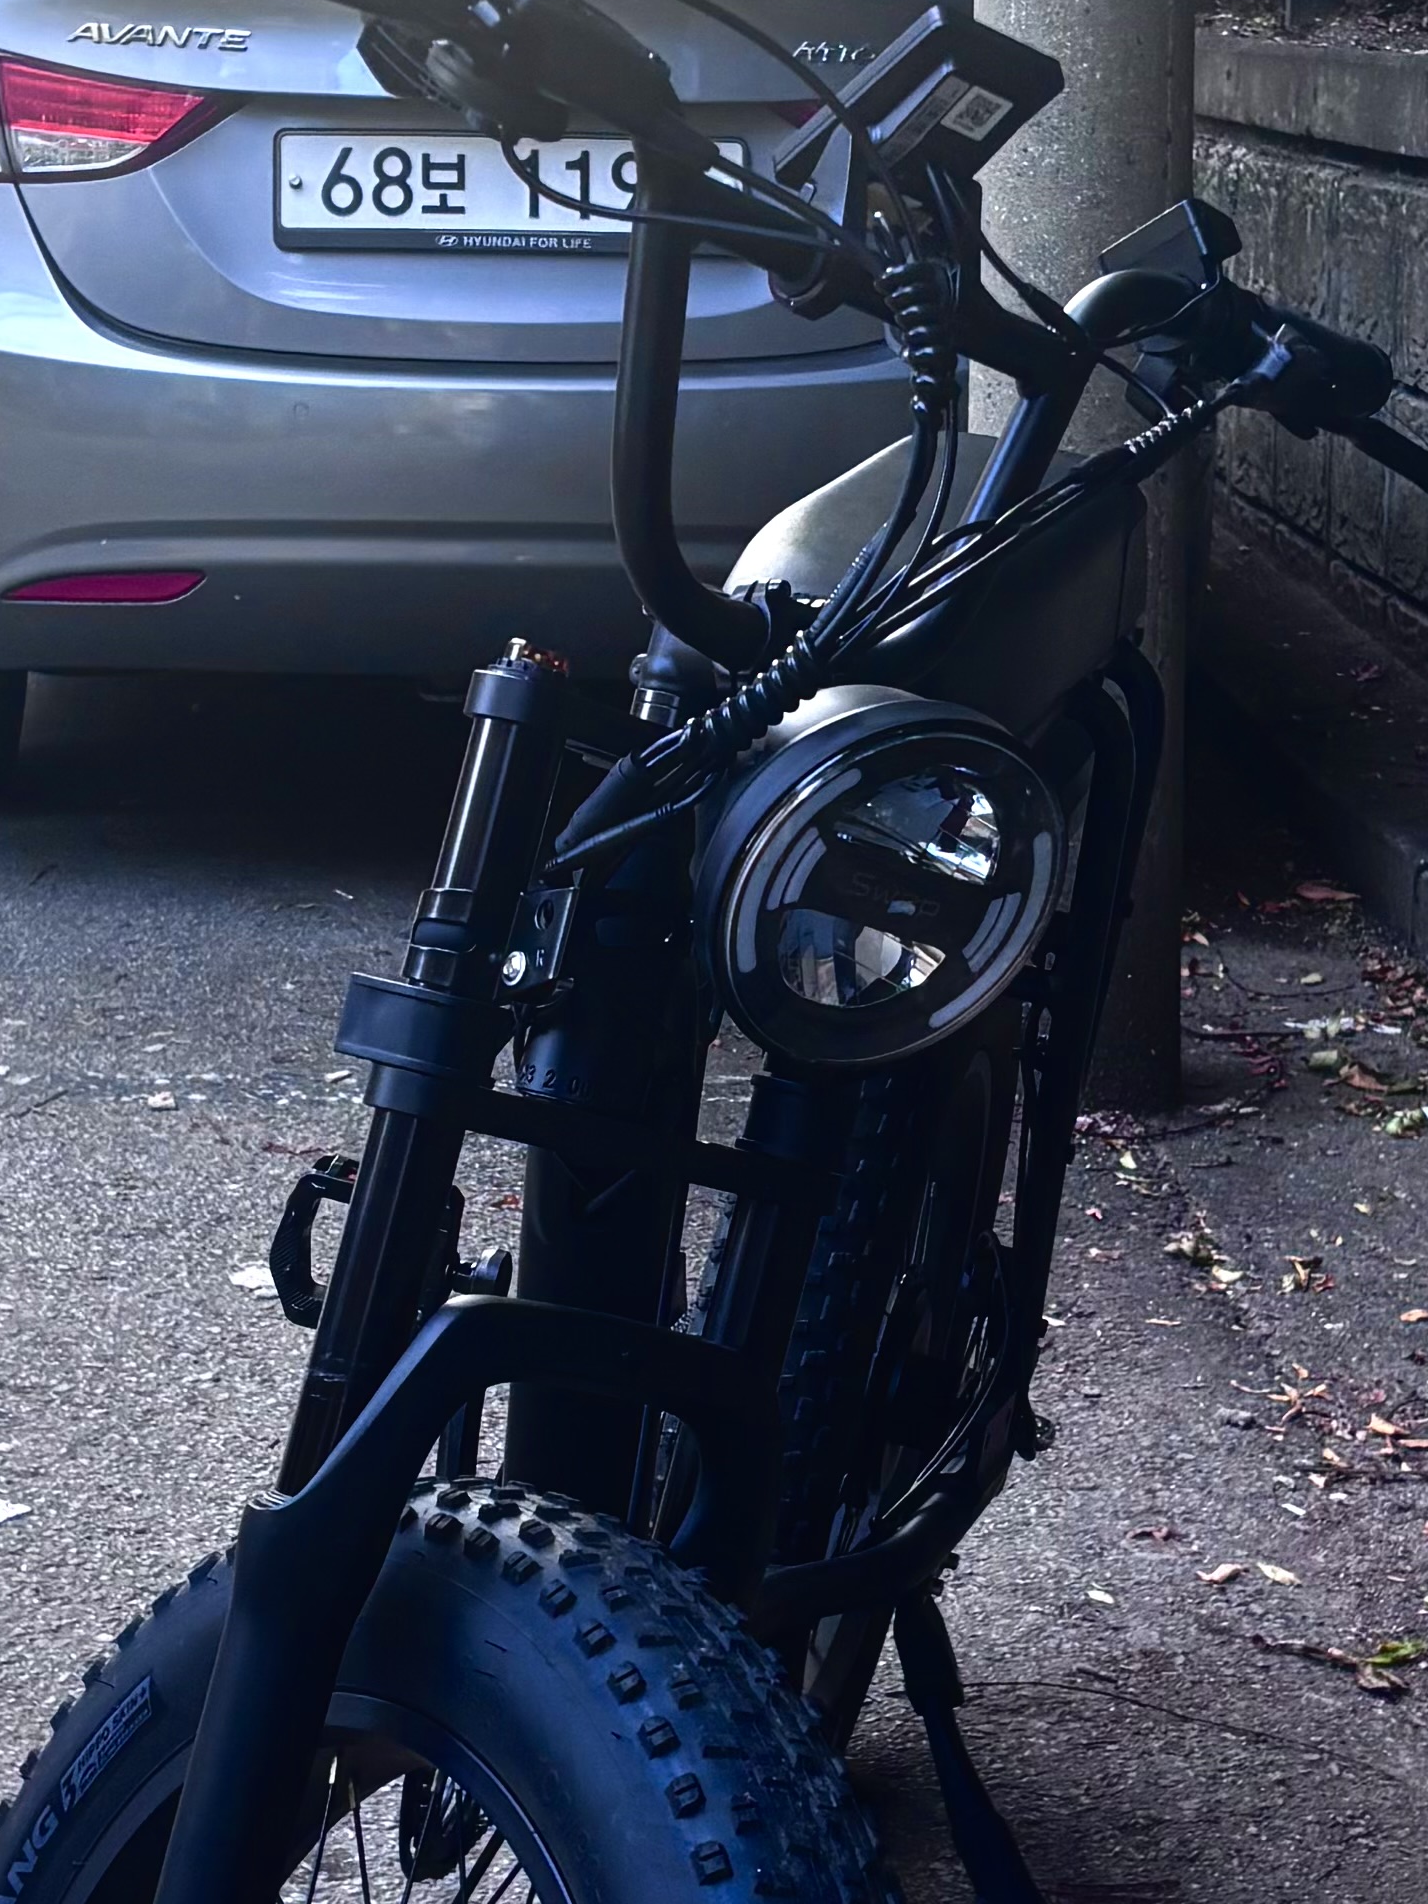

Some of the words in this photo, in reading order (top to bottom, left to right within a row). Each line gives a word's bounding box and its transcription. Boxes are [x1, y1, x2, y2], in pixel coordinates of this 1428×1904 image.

[66, 22, 252, 52] AVANTE
[321, 146, 467, 217] 68보
[519, 149, 639, 220] 119
[462, 235, 526, 249] HYUNDAI
[529, 236, 558, 250] FOR
[562, 237, 593, 251] LIFE
